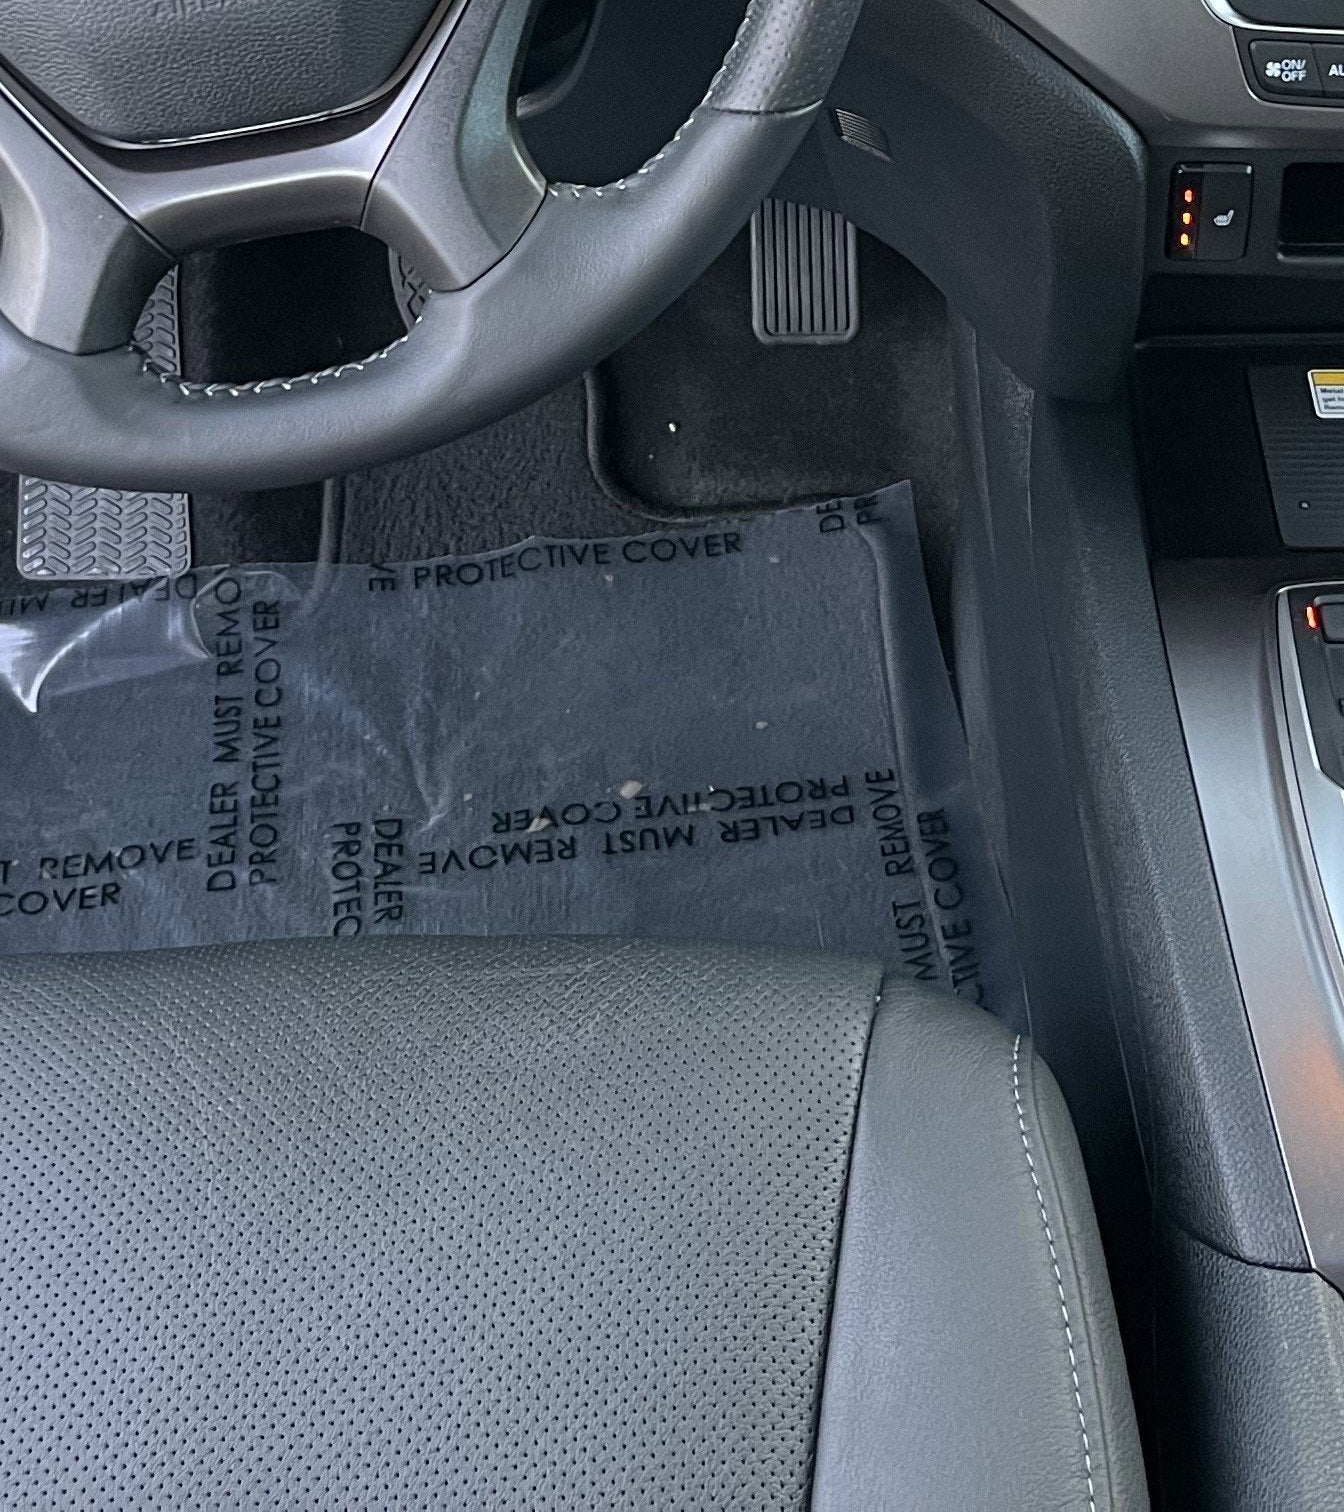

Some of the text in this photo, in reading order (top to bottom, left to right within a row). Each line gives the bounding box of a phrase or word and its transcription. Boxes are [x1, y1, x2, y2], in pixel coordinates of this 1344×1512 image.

[1281, 69, 1307, 83] OFF
[412, 541, 612, 591] PROTECTIVE
[620, 531, 743, 564] COVER
[212, 693, 245, 765] MUST
[248, 599, 284, 889] PROTECTIVE COVER
[205, 781, 241, 894] DEALER
[418, 803, 857, 877] DEALER MUST REMOVE
[490, 773, 852, 836] PROTECTIVE COVER
[37, 836, 198, 882] REMOVE
[372, 816, 405, 926] DEALER
[863, 767, 940, 982] MUST REMOVE
[915, 806, 965, 912] COVER
